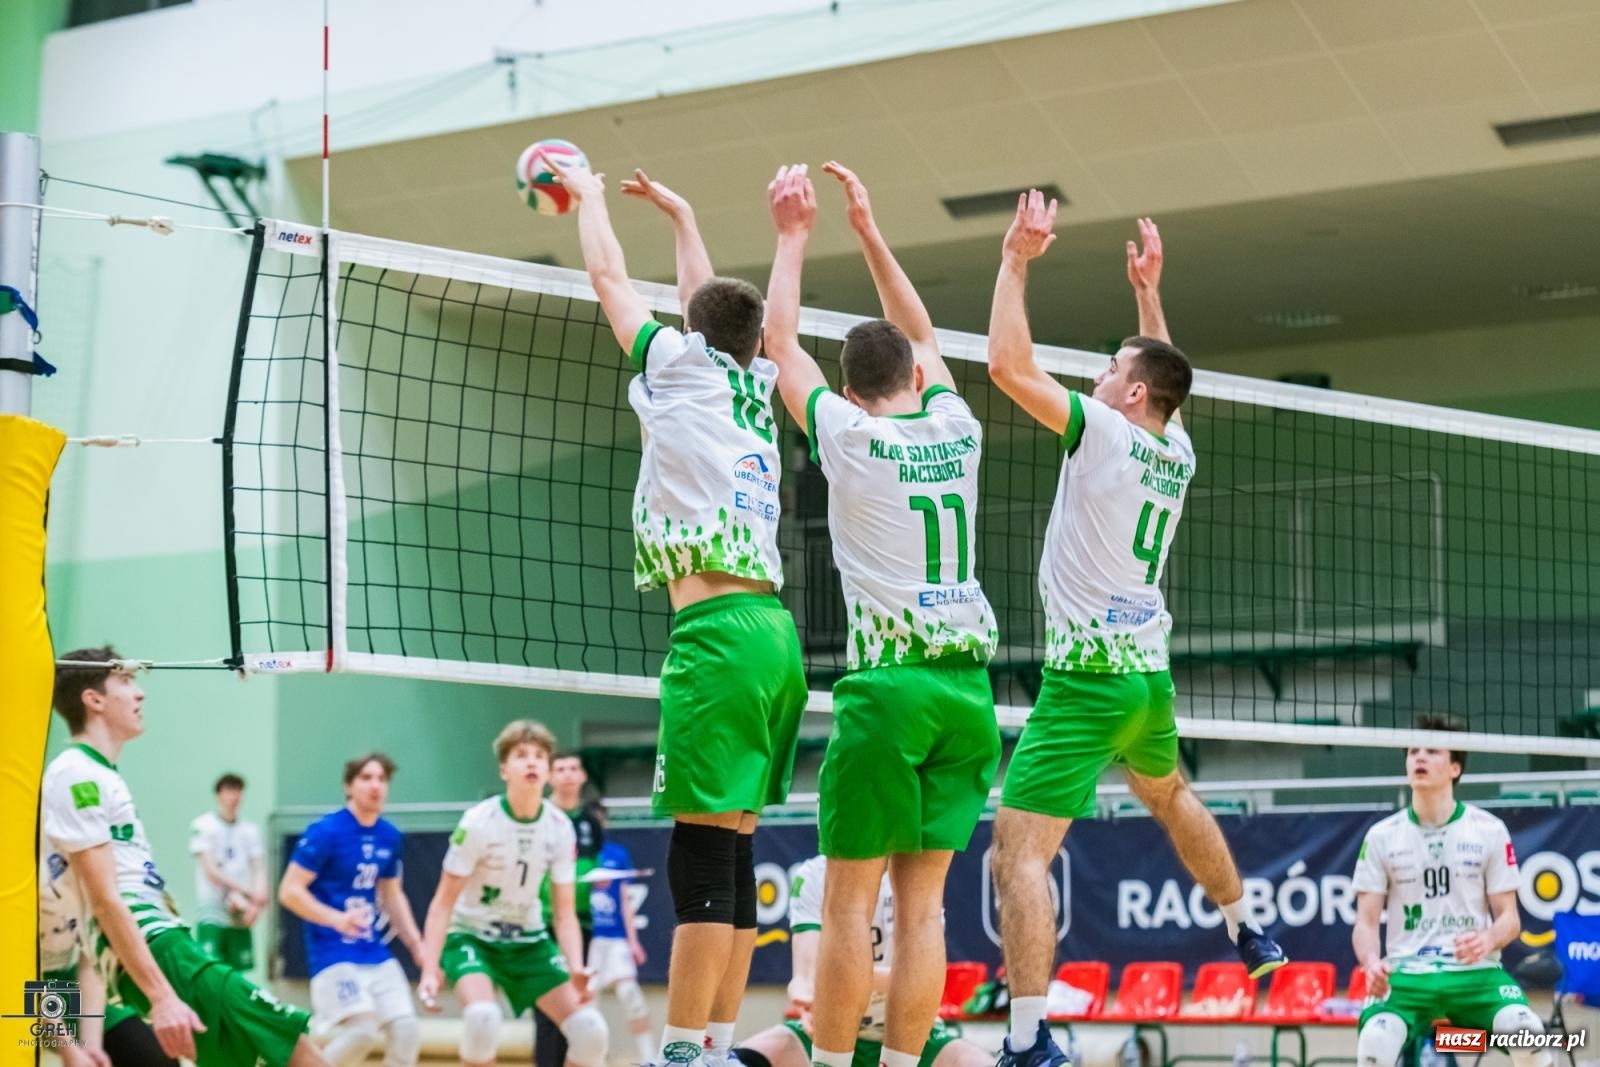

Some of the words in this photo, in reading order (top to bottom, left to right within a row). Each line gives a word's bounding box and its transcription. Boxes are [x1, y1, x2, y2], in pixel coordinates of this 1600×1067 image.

[278, 231, 313, 245] netex
[909, 493, 968, 585] 11
[1132, 500, 1171, 585] 4
[517, 861, 528, 887] 7
[1117, 859, 1388, 931] RACBÓR
[1424, 865, 1450, 899] 99
